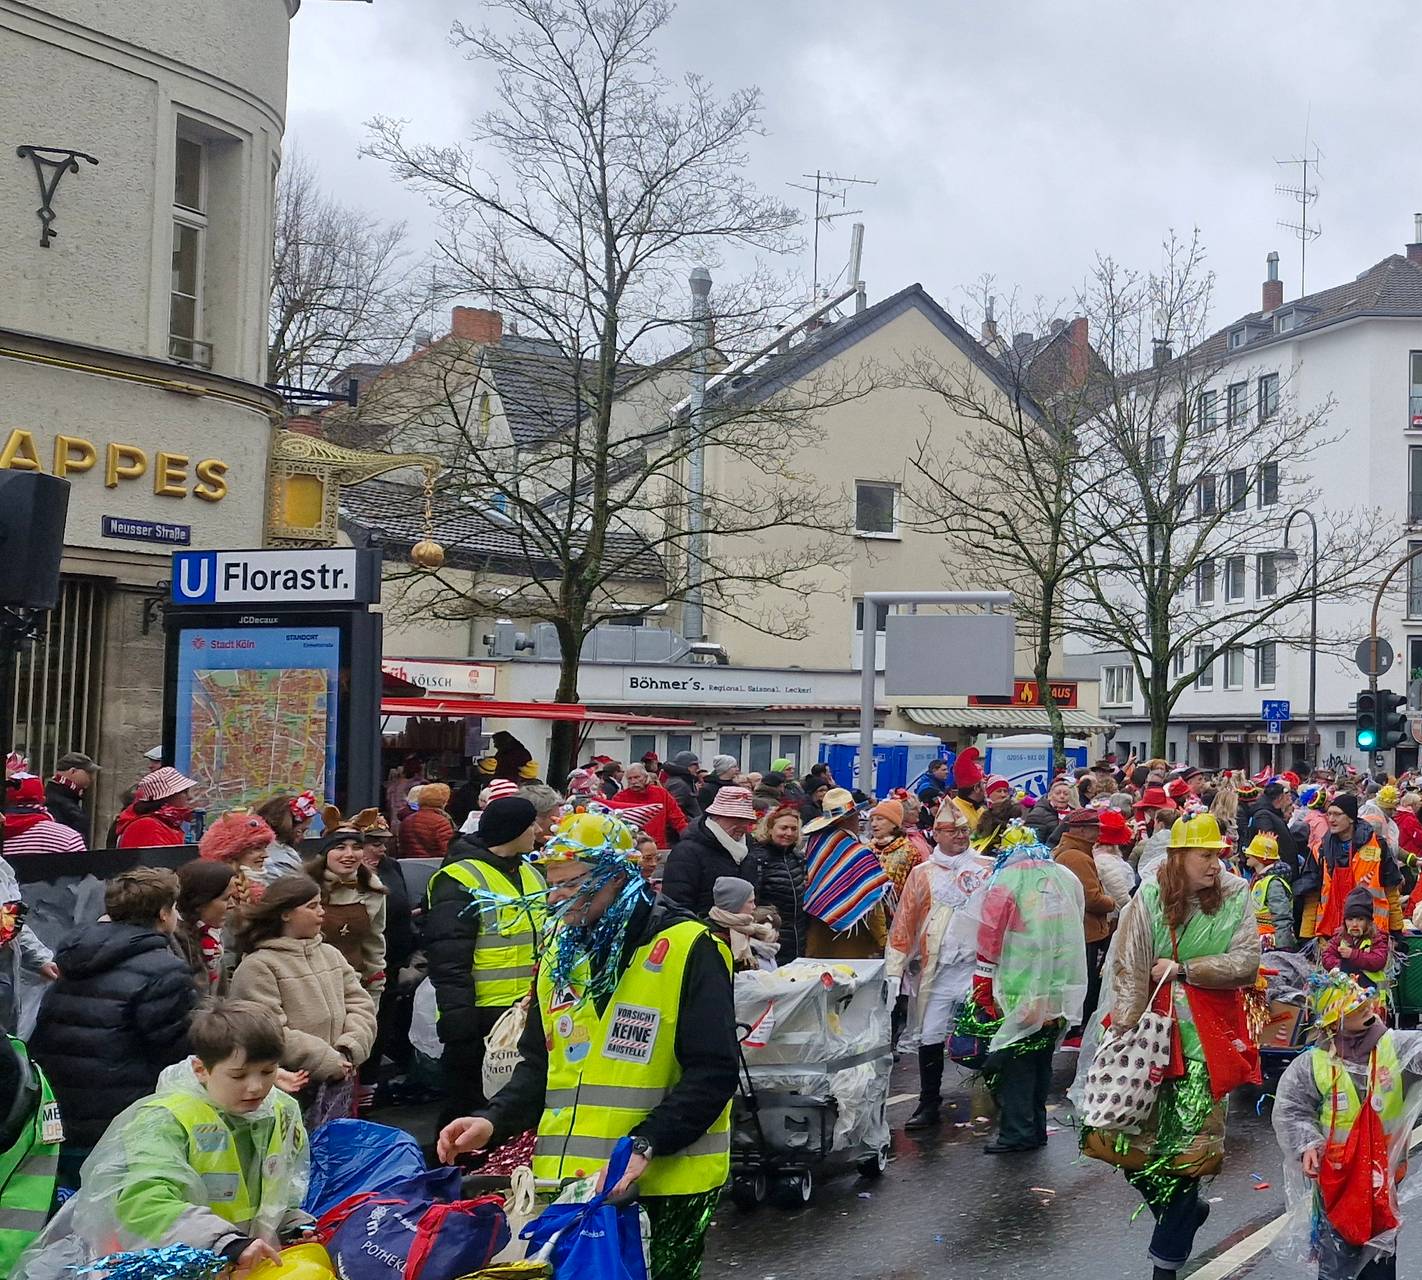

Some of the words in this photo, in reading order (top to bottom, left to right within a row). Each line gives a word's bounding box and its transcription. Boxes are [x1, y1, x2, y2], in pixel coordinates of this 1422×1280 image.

[0, 428, 229, 501] APPES
[110, 519, 153, 536] Neusser
[155, 525, 187, 541] Straße
[180, 558, 208, 598] U
[223, 562, 349, 591] Florastr.
[238, 616, 279, 625] JCDecaux
[210, 640, 234, 649] Stadt
[235, 638, 256, 649] Köln
[411, 674, 452, 688] KÖLSCH
[617, 1006, 657, 1023] VORSICHT
[611, 1021, 652, 1043] KEINE
[606, 1043, 647, 1058] BAUSTELLE
